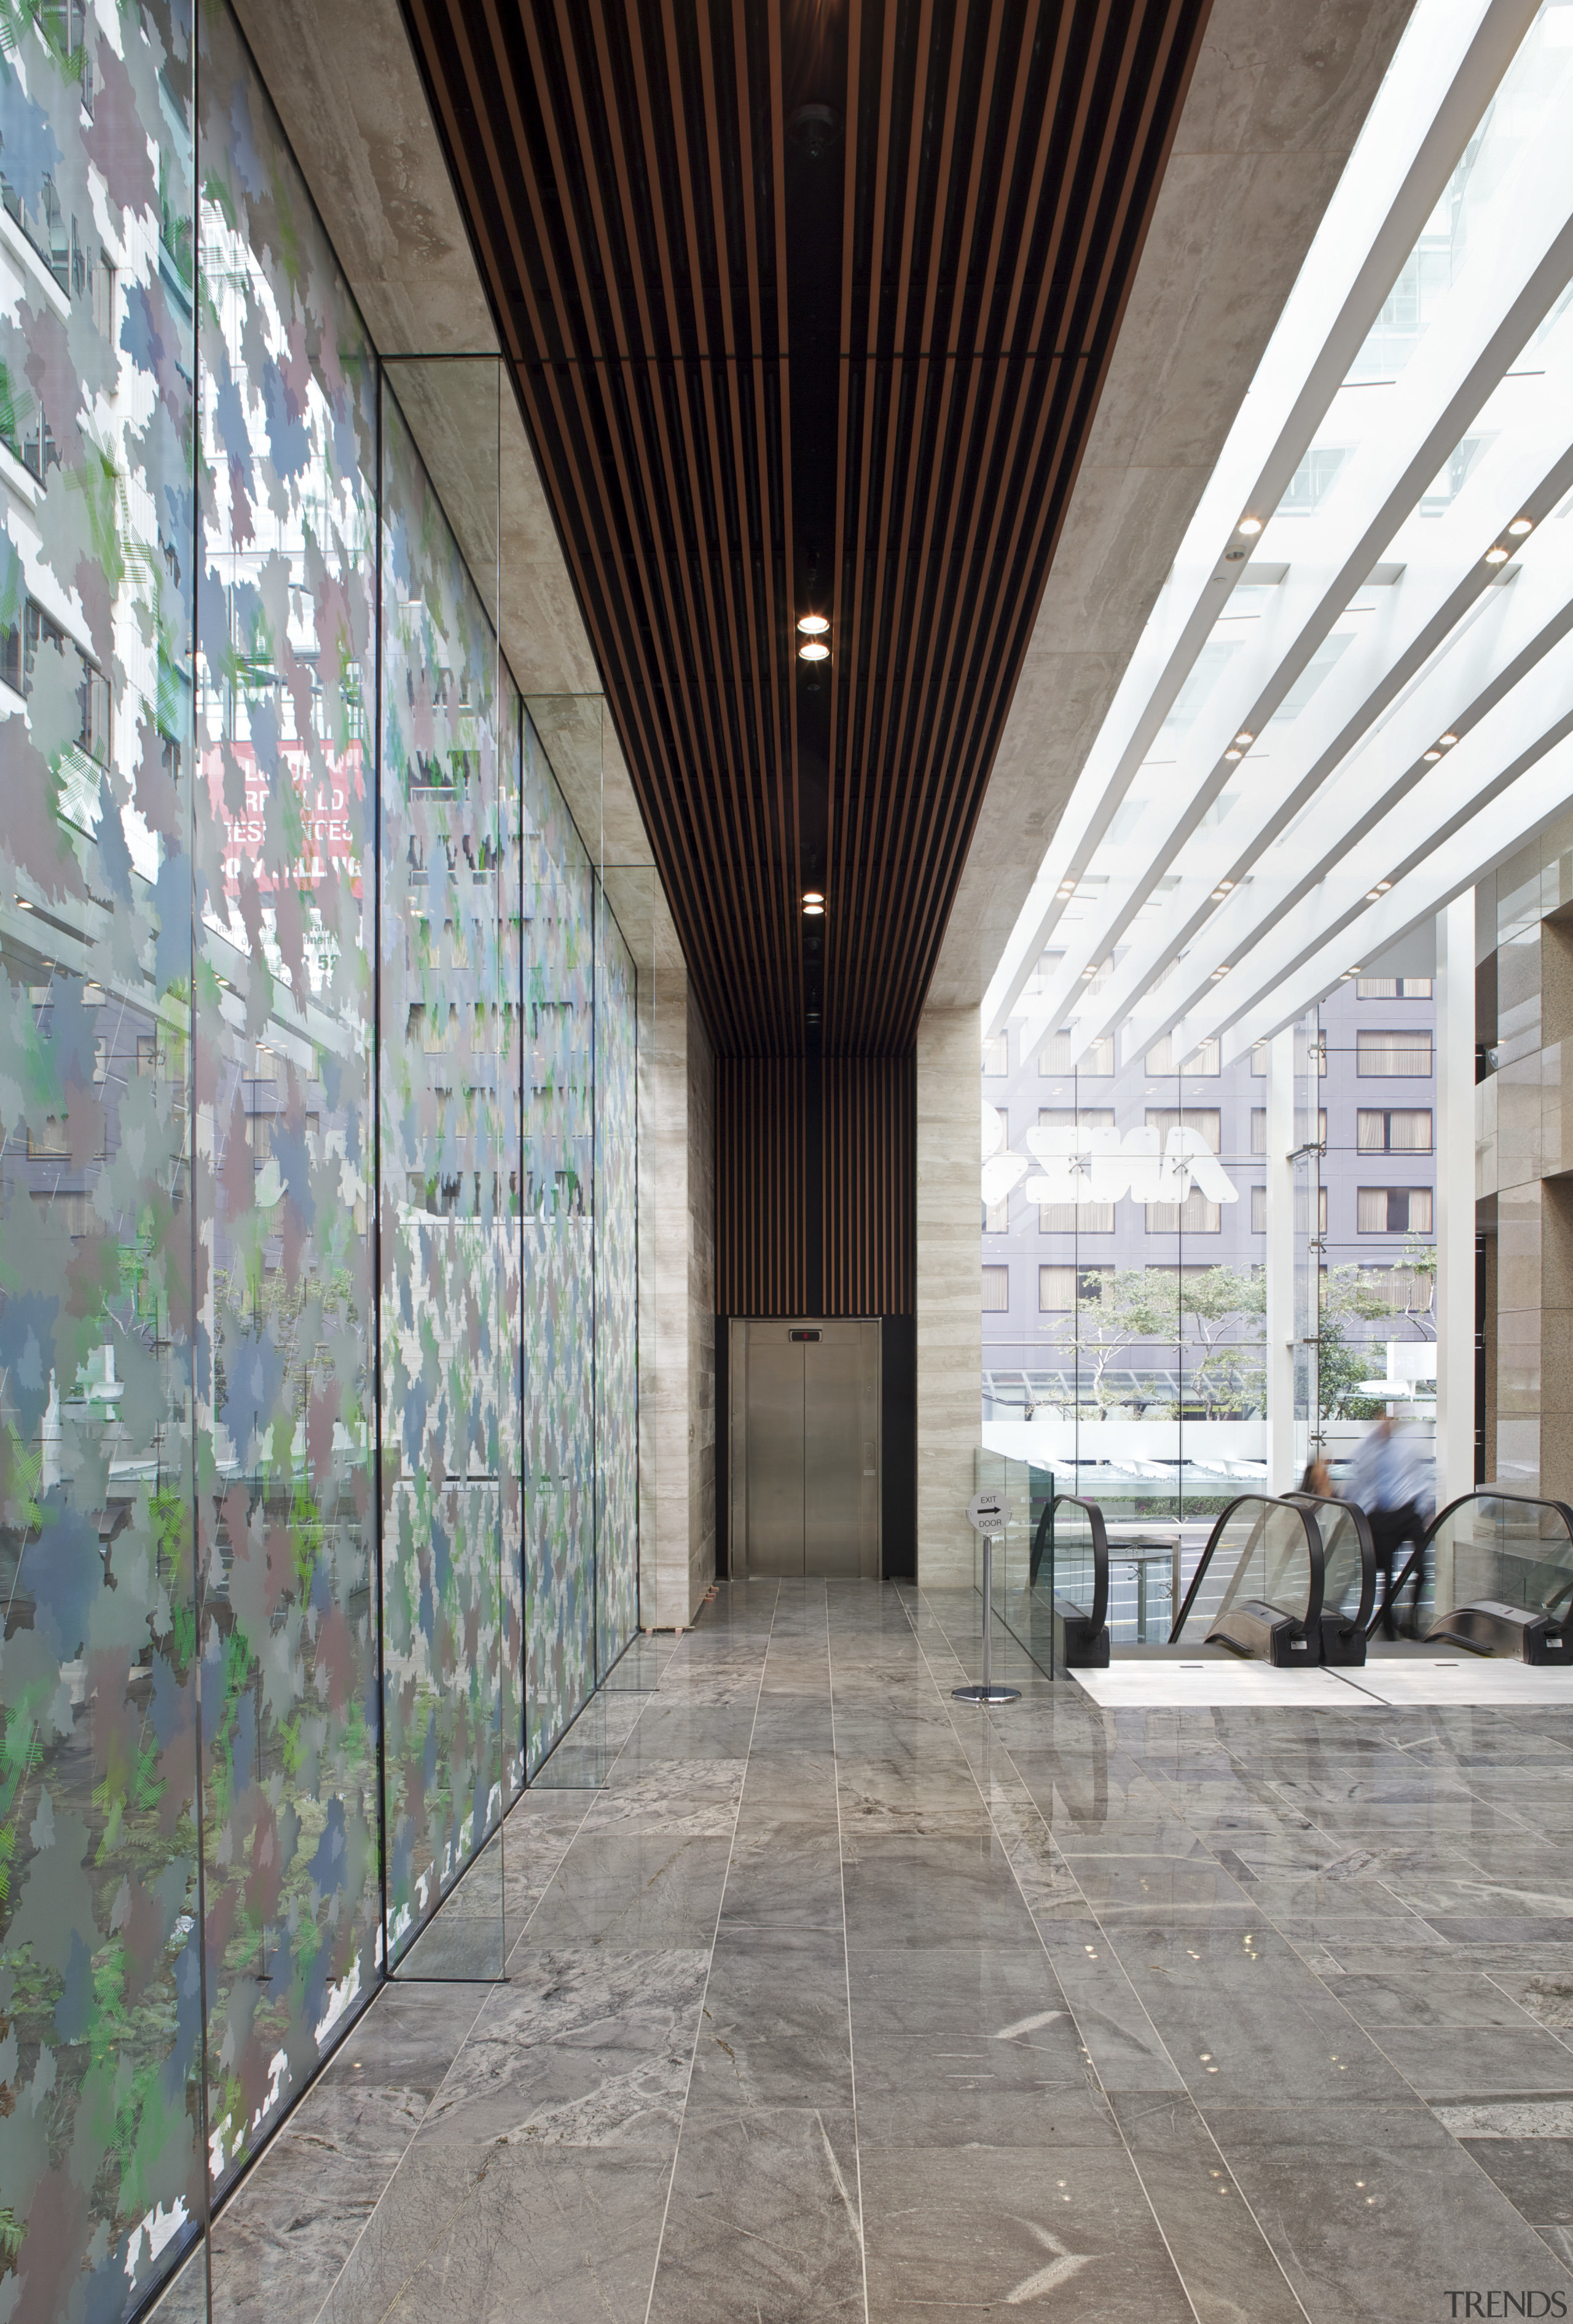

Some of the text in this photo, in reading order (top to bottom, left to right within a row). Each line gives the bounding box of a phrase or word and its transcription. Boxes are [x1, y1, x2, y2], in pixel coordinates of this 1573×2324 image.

[224, 820, 353, 842] RESINCES
[272, 857, 362, 878] ELLNG
[216, 923, 273, 935] Inspecs
[979, 1519, 1002, 1528] DOOR
